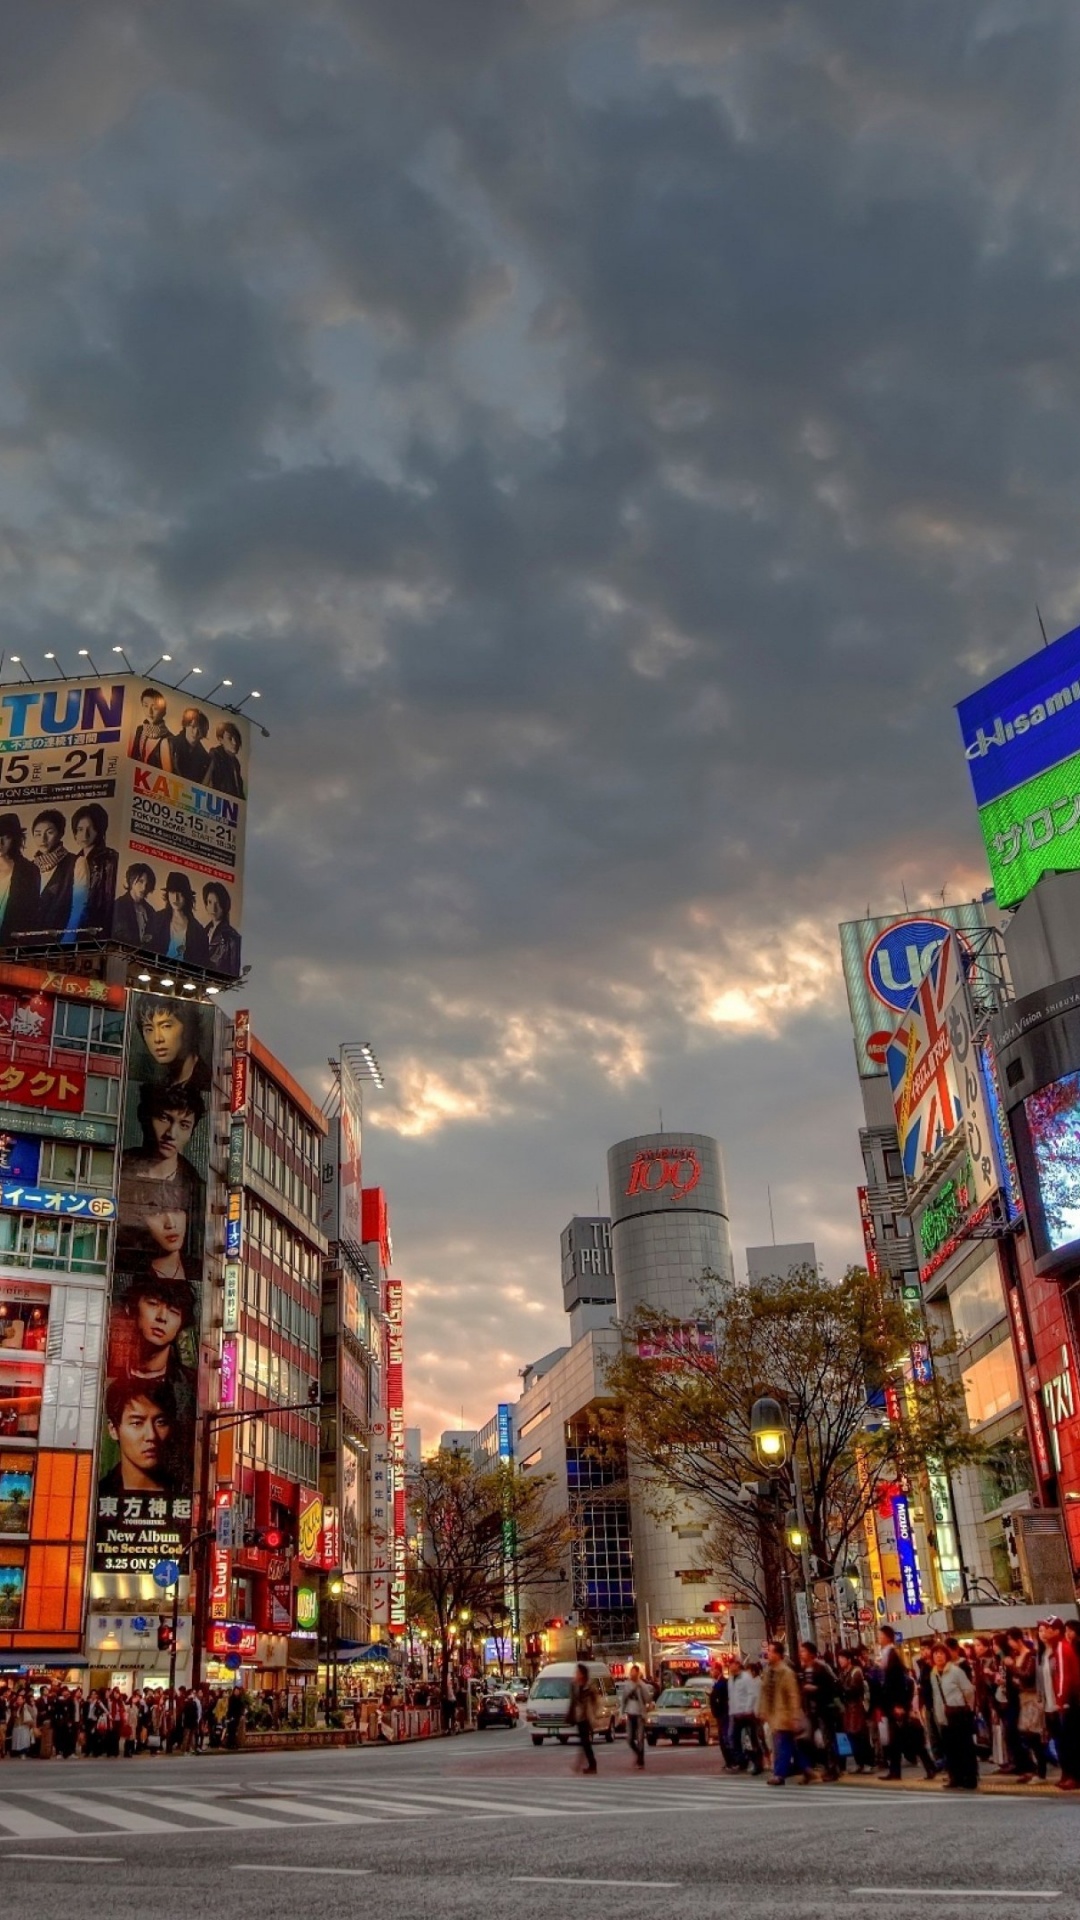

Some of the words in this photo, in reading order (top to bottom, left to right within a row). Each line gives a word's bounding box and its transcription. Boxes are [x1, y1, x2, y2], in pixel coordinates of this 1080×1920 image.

[0, 685, 125, 738] TUN
[23, 786, 47, 796] SALE
[132, 767, 239, 822] KAT-TUN
[131, 810, 160, 824] TOKYO
[162, 821, 185, 834] DOME
[1015, 1011, 1042, 1033] Vision
[1045, 994, 1080, 1014] SHIBUYA
[0, 1066, 80, 1100] タクト
[625, 1157, 702, 1201] 109
[5, 1188, 87, 1213] イーオン
[91, 1201, 110, 1214] 6F
[590, 1222, 612, 1248] TH
[580, 1248, 612, 1275] PRI
[99, 1497, 191, 1519] 東方神起
[896, 1503, 908, 1539] MIZUHO
[97, 1542, 118, 1554] The
[121, 1543, 158, 1554] Secret
[160, 1544, 186, 1555] Cod
[107, 1529, 136, 1542] New
[138, 1529, 180, 1543] Album
[105, 1558, 128, 1570] 3.25
[130, 1558, 147, 1570] ON
[373, 1535, 385, 1610] マルナン
[657, 1625, 694, 1637] SPRING
[696, 1624, 717, 1636] FAIR
